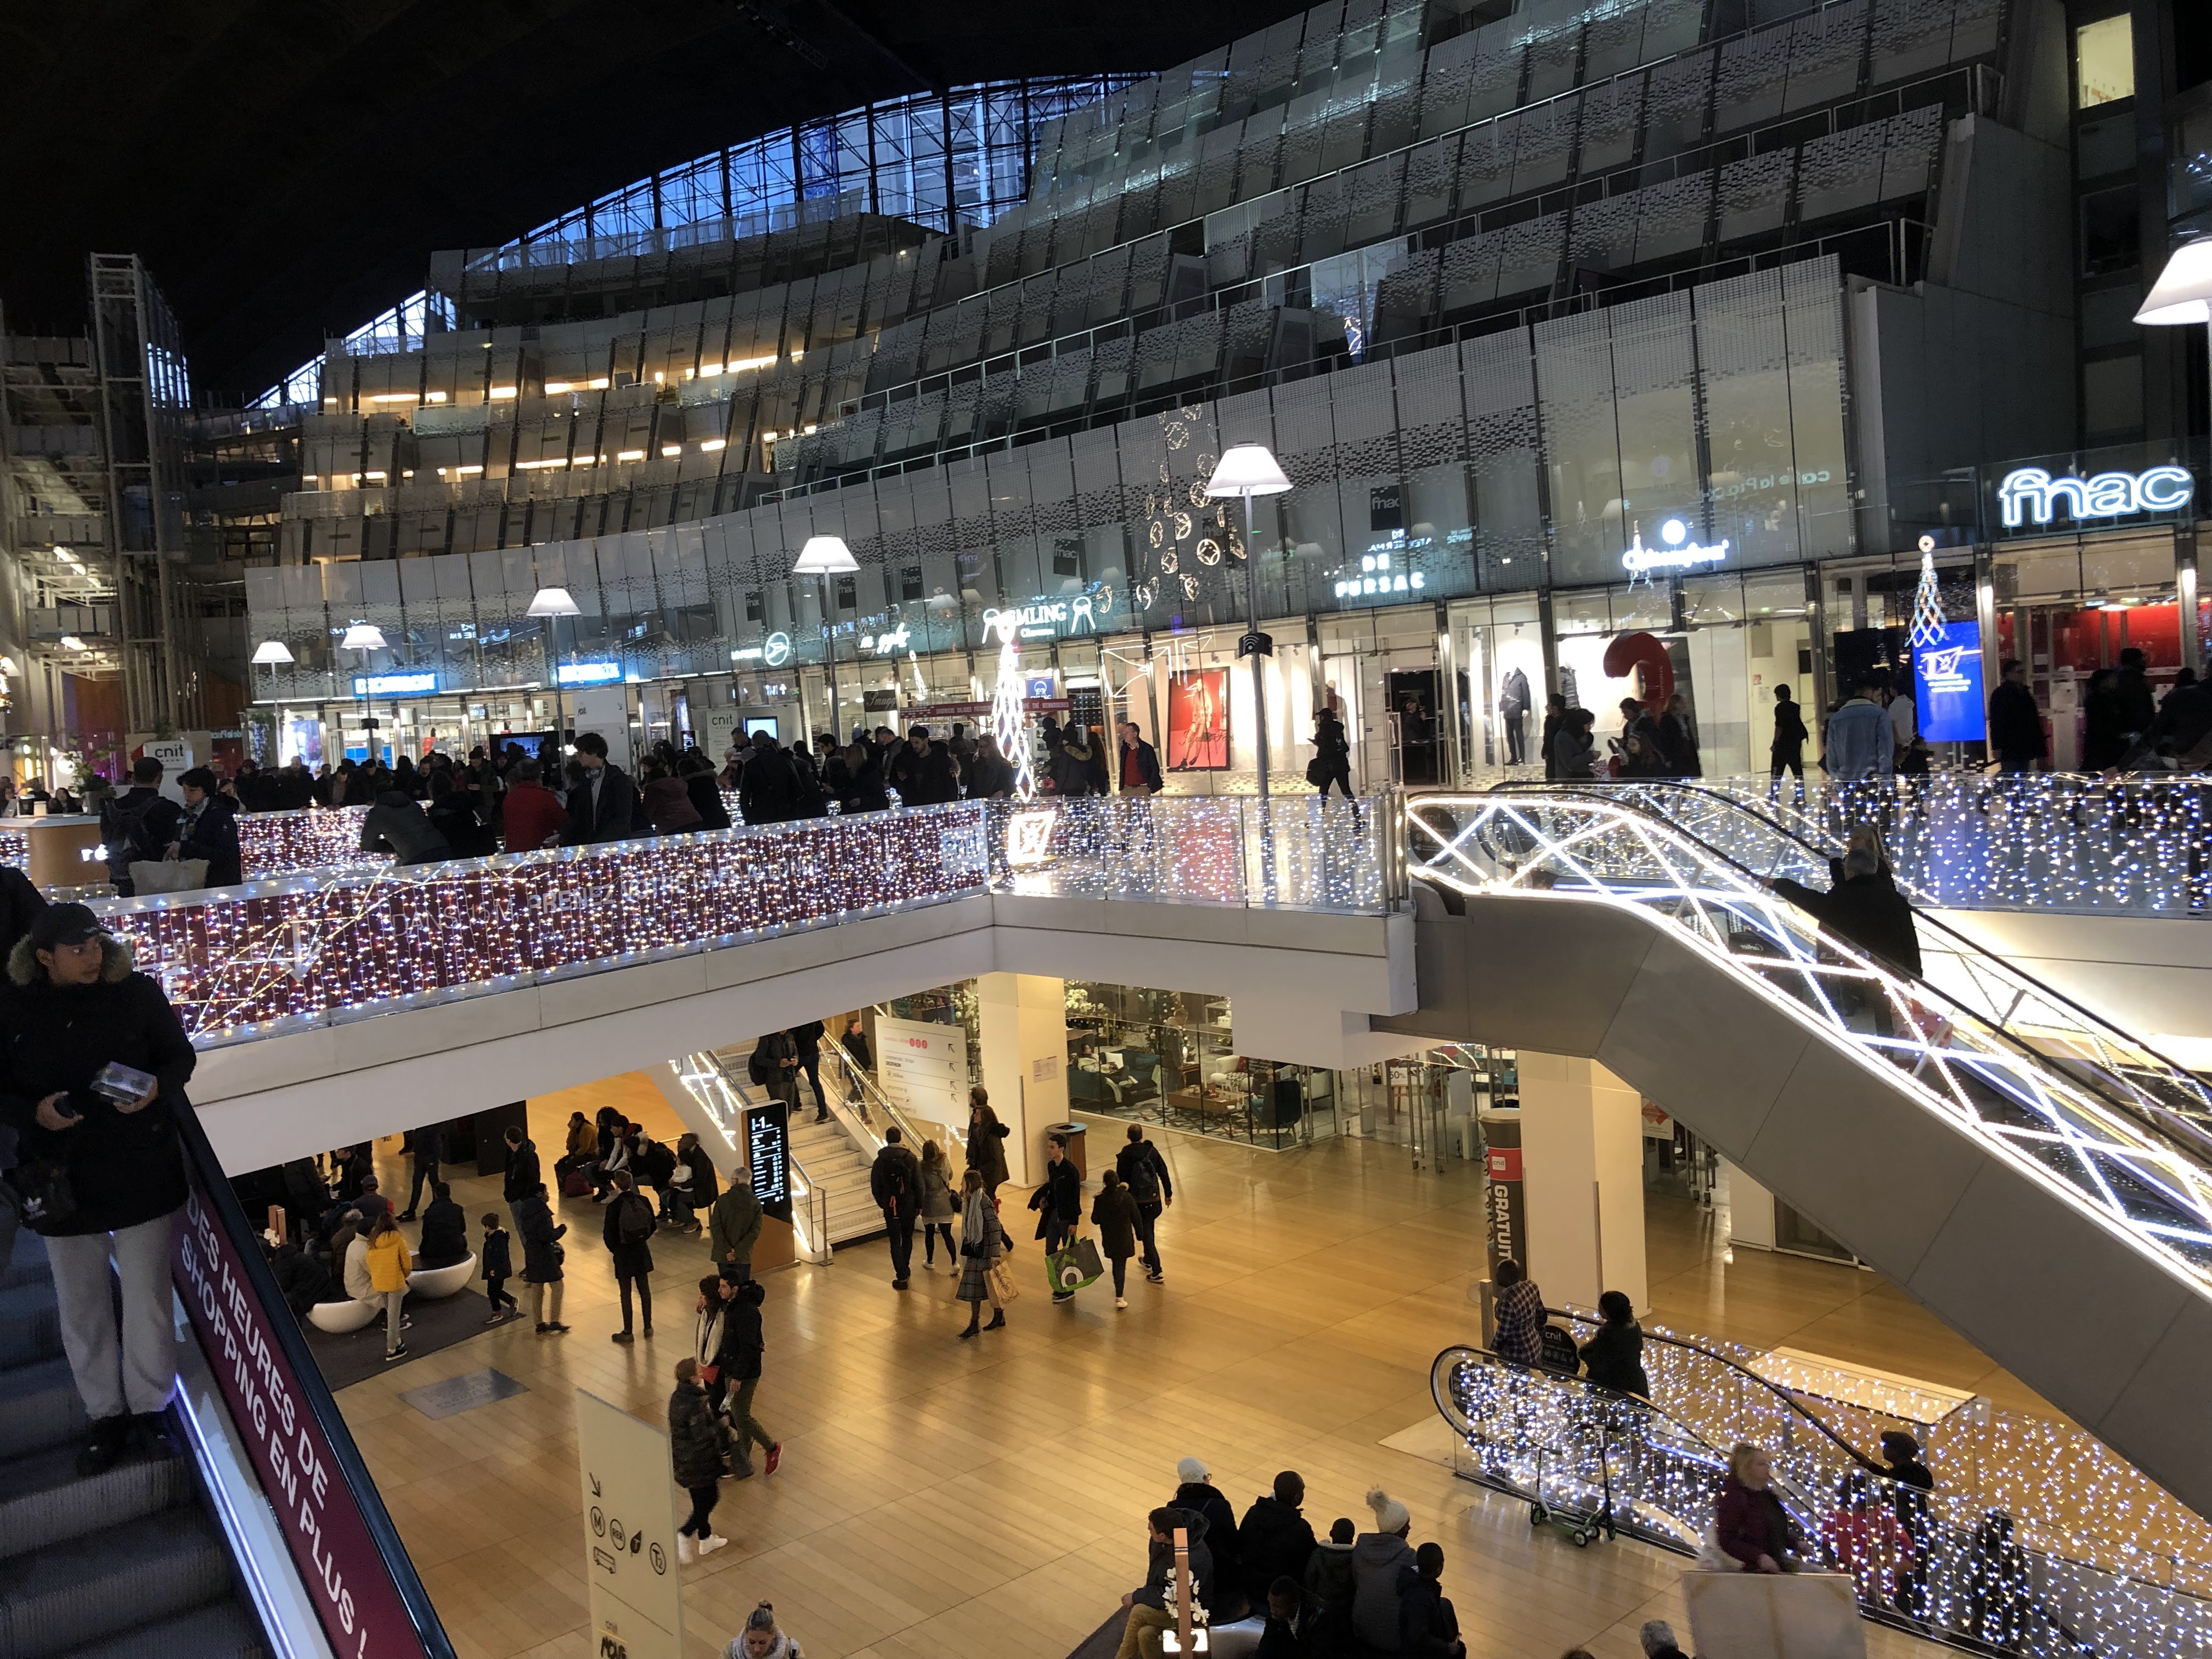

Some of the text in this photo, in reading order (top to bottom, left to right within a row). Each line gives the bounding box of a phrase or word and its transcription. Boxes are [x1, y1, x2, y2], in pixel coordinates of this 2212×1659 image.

[1999, 466, 2194, 527] fnac
[1055, 545, 1077, 559] fnac
[1362, 553, 1390, 572] DE
[903, 574, 921, 585] fnac
[712, 714, 733, 725] cnit
[155, 744, 184, 758] cnit
[527, 883, 616, 916] PRENEZ
[1494, 1184, 1513, 1260] GRATUIT
[186, 1185, 329, 1511] DES HEURES DE
[1545, 1331, 1561, 1341] cnit
[181, 1234, 267, 1441] SHOPPING
[269, 1430, 298, 1508] EN
[299, 1497, 355, 1633] PLUS
[594, 1512, 602, 1531] M
[652, 1548, 663, 1570] T2
